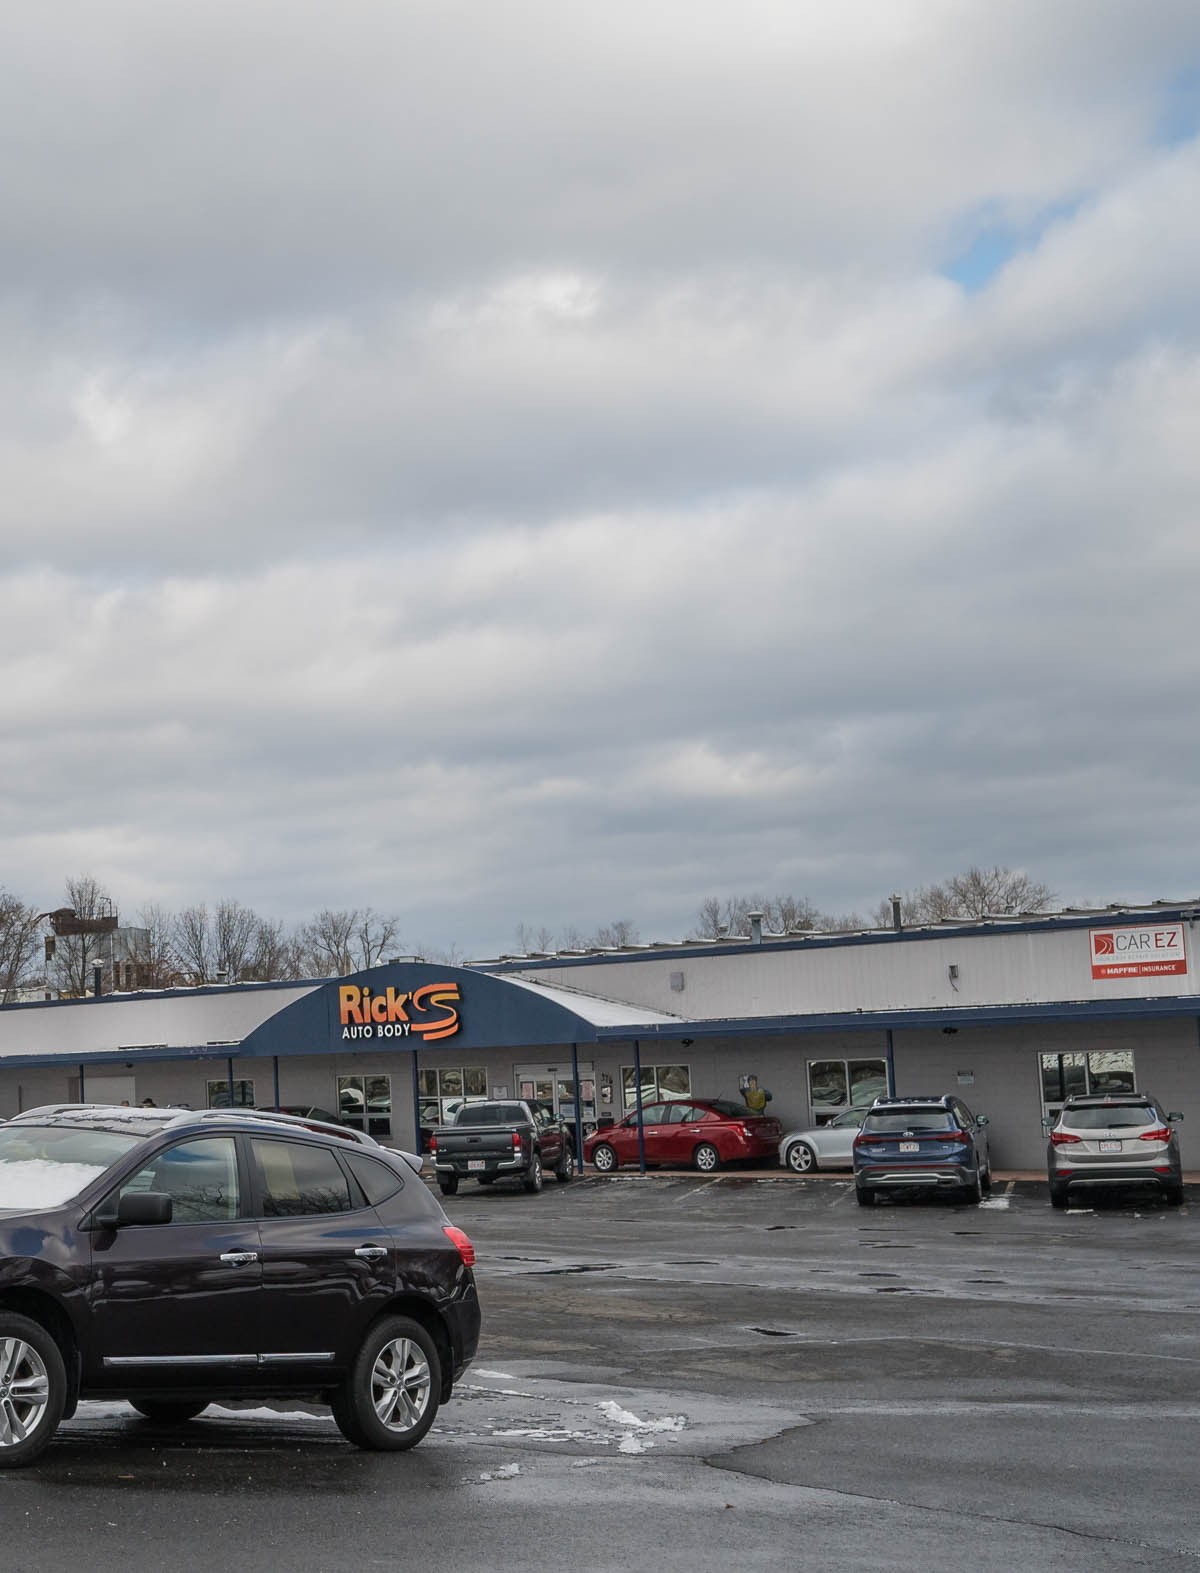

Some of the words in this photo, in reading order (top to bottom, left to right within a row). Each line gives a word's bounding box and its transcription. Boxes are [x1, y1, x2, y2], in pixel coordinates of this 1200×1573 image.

[1141, 965, 1176, 973] INSURANCE
[342, 1026, 372, 1039] AUTO
[378, 1023, 411, 1038] BODY
